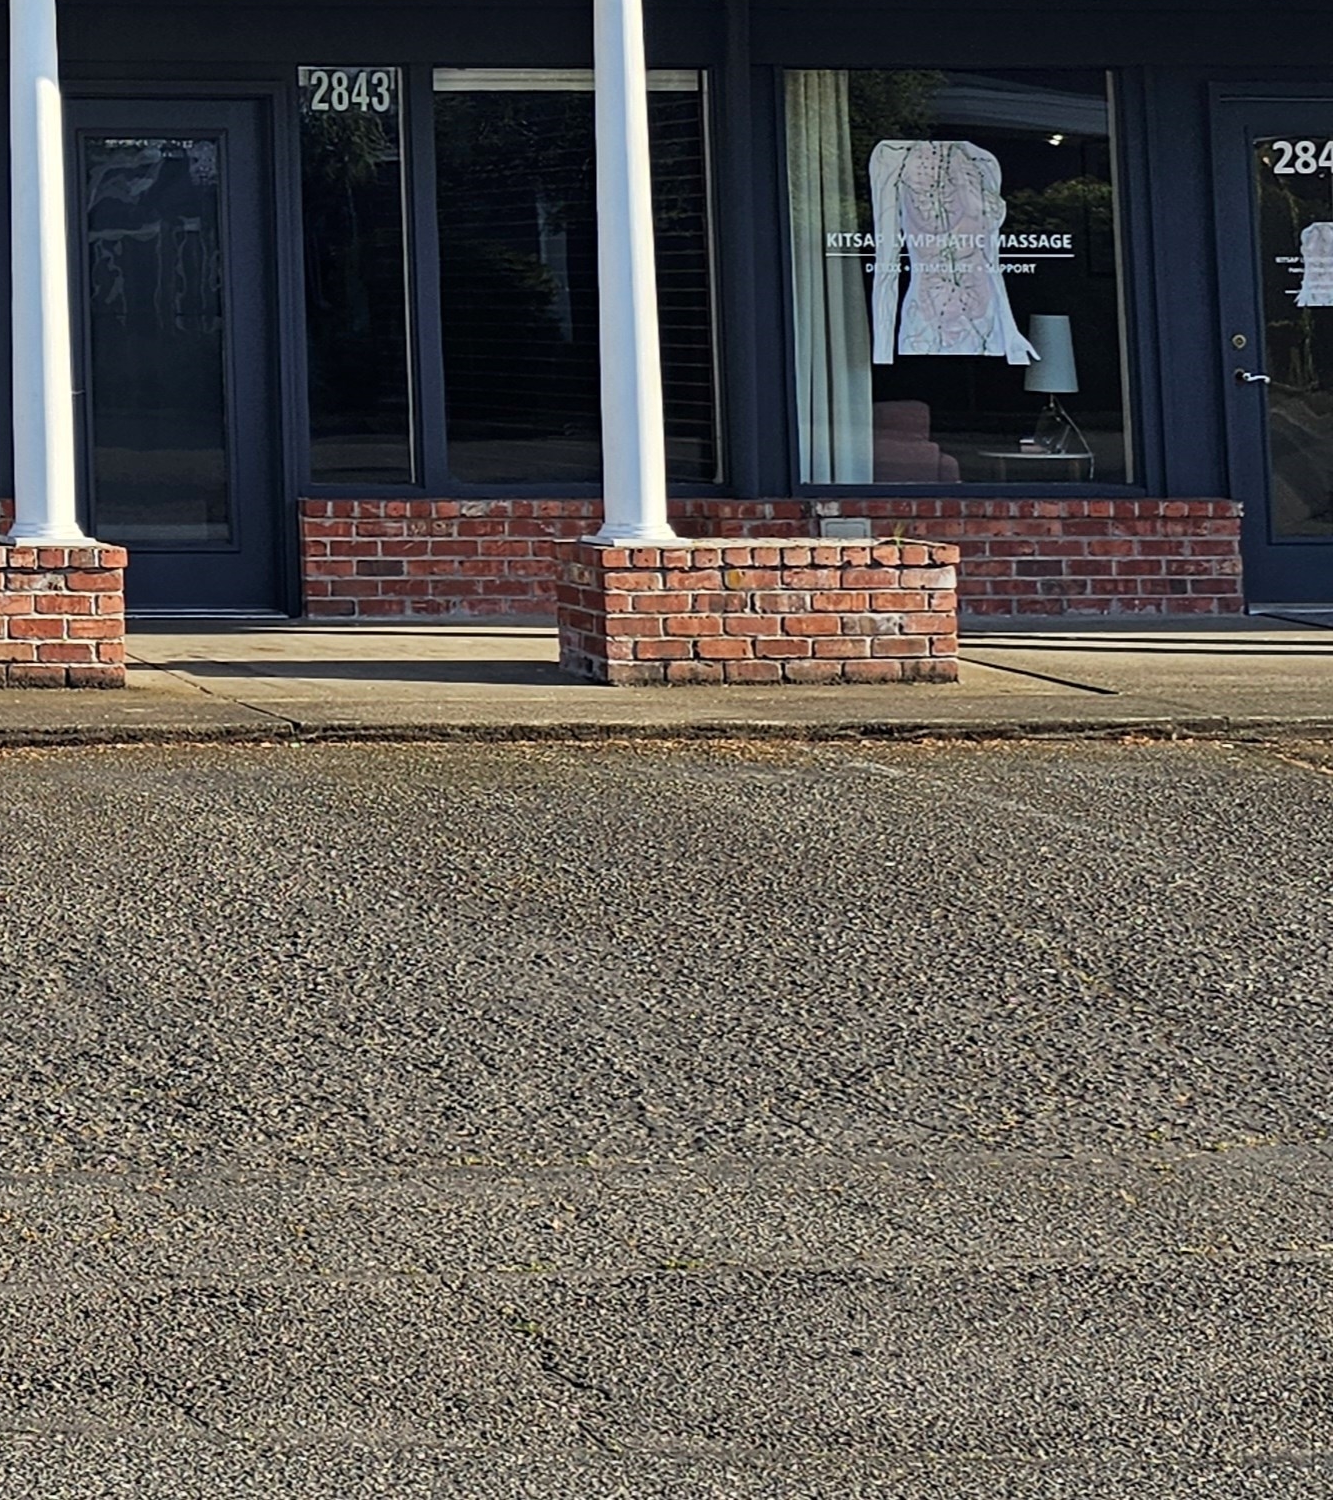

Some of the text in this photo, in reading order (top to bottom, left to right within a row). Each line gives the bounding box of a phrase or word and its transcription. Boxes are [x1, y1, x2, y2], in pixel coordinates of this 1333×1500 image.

[310, 71, 390, 112] 2843
[826, 232, 1072, 249] KITSAP LYMPHATIC MASSAGE
[865, 263, 902, 273] DOX
[913, 263, 973, 273] TIMULTE
